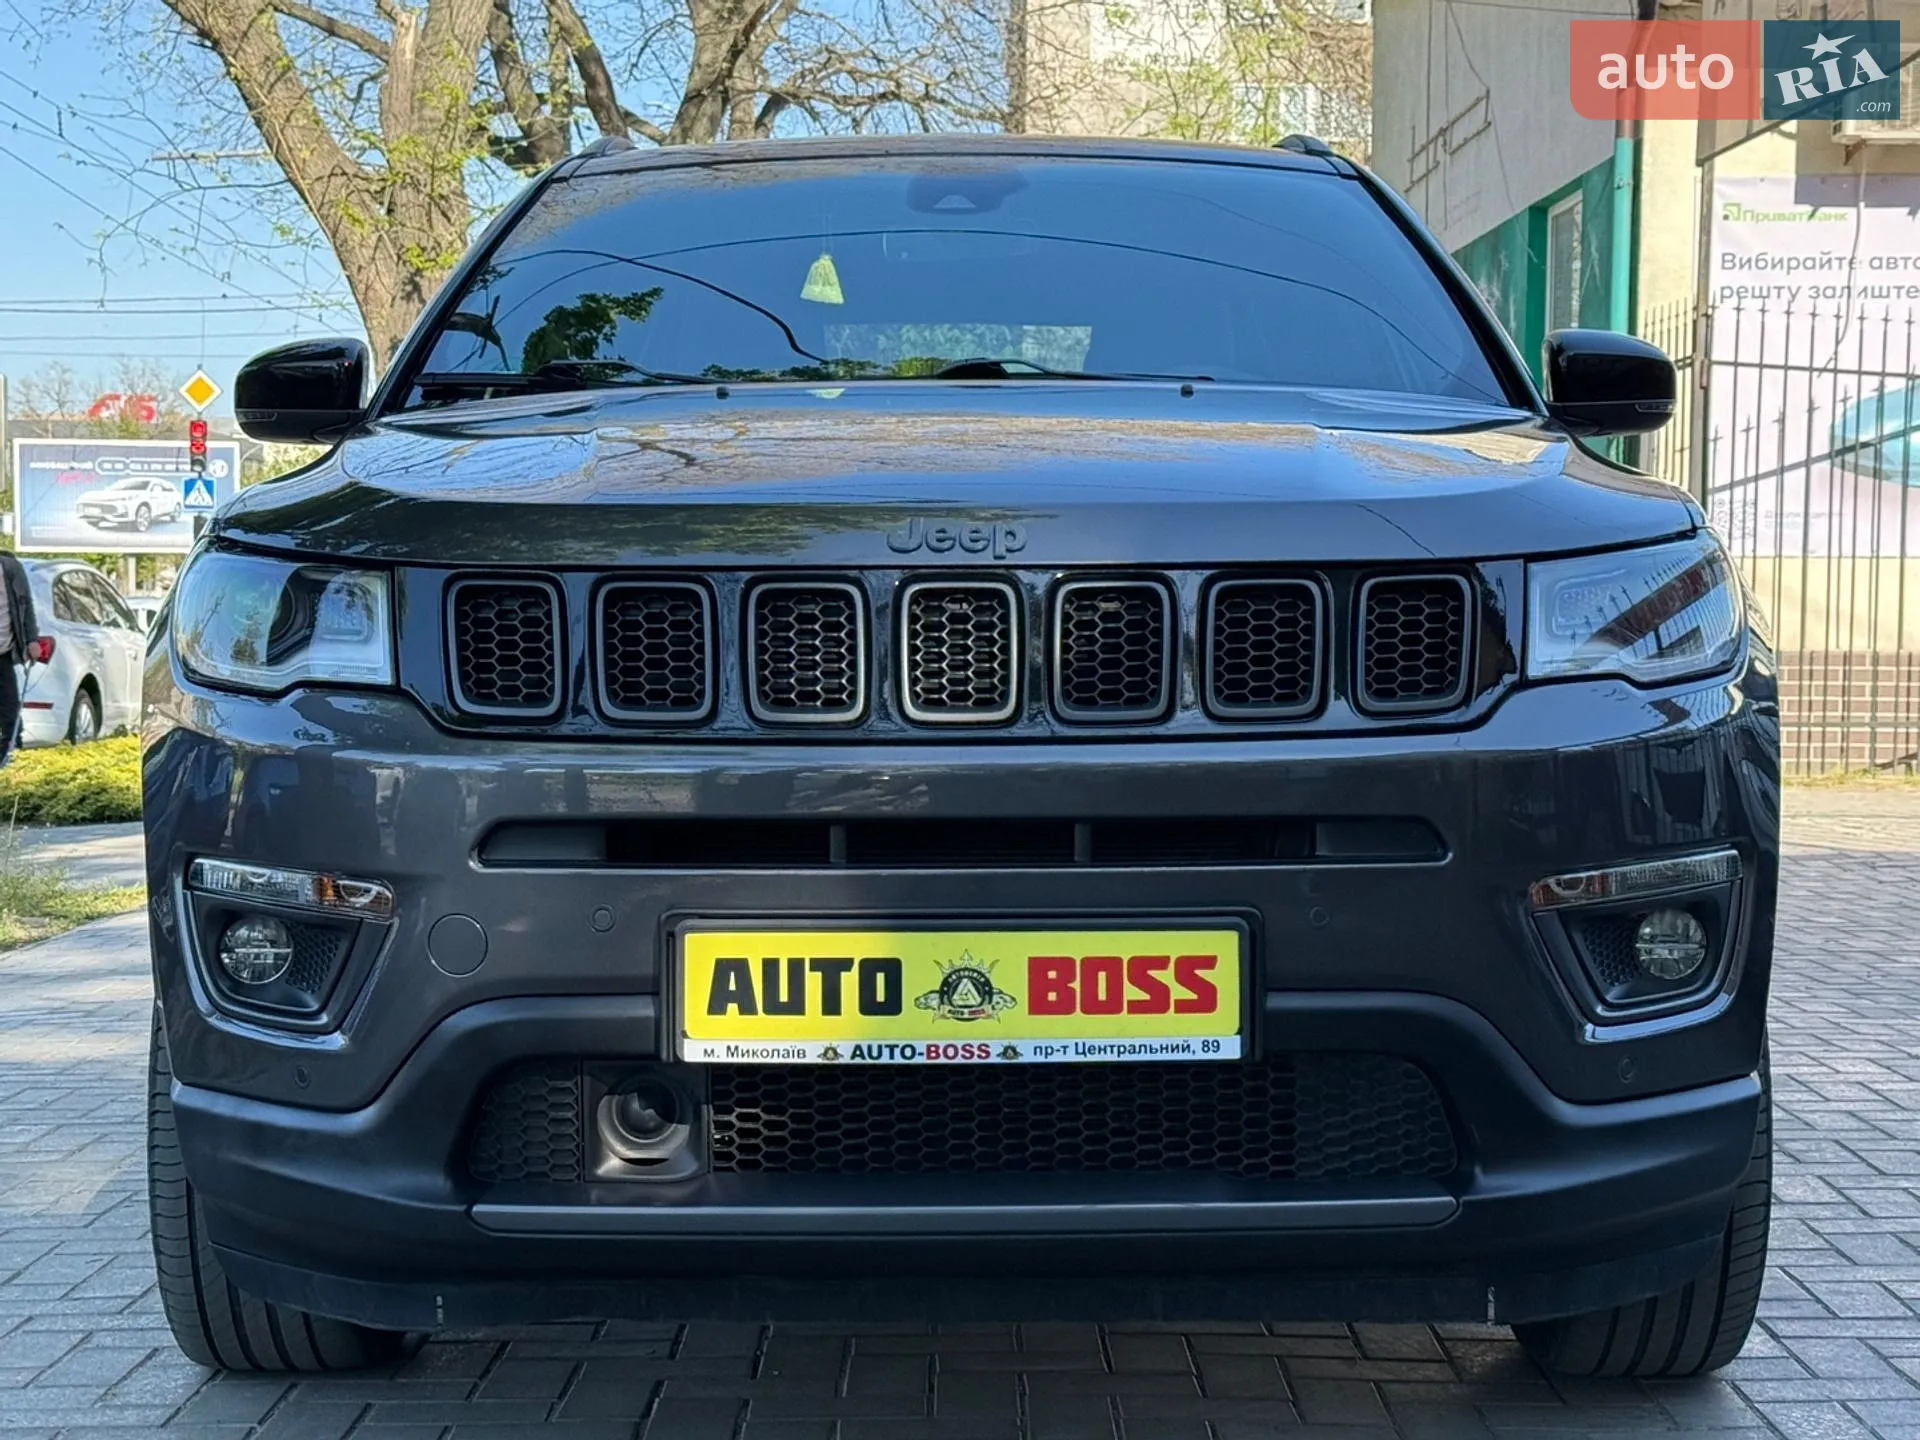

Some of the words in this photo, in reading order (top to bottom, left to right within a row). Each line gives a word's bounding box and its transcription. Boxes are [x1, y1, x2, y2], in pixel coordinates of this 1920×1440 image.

[1720, 284, 1802, 304] решту
[886, 516, 1028, 560] Jeep
[706, 957, 903, 1017] AUTO
[1027, 954, 1219, 1016] BOSS
[703, 1046, 720, 1059] м.
[726, 1044, 807, 1060] Миколаїв
[850, 1043, 991, 1061] AUTO-BOSS
[1033, 1044, 1069, 1059] пр-т
[1074, 1040, 1196, 1058] Центральний,
[1201, 1039, 1221, 1054] 89
